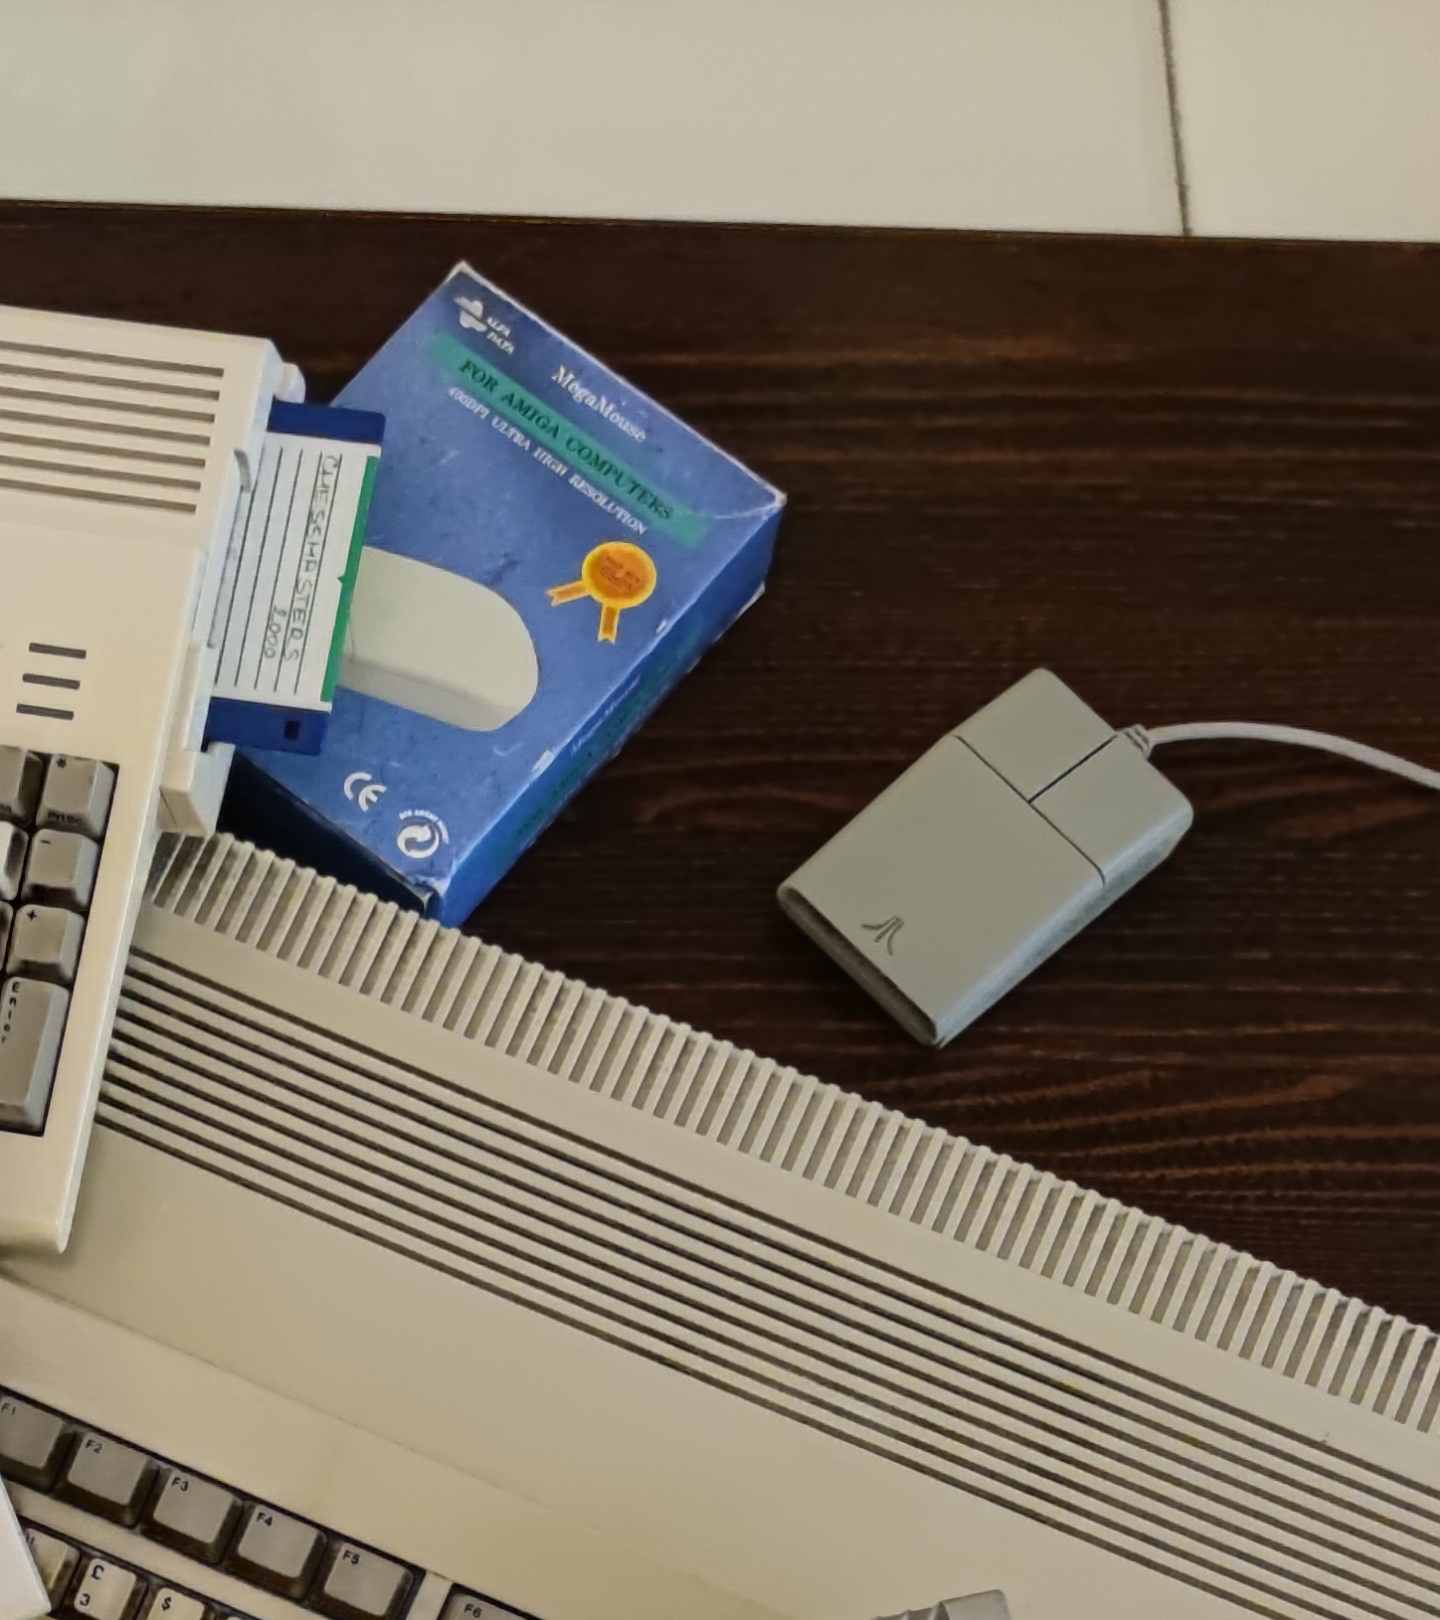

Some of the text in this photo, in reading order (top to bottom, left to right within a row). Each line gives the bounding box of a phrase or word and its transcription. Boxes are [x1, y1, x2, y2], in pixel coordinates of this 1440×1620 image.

[460, 360, 671, 520] FOR AMIGA COMPUTERS
[491, 418, 531, 451] ULTRA
[533, 447, 569, 477] HIGH
[569, 475, 648, 535] RESOLUTION
